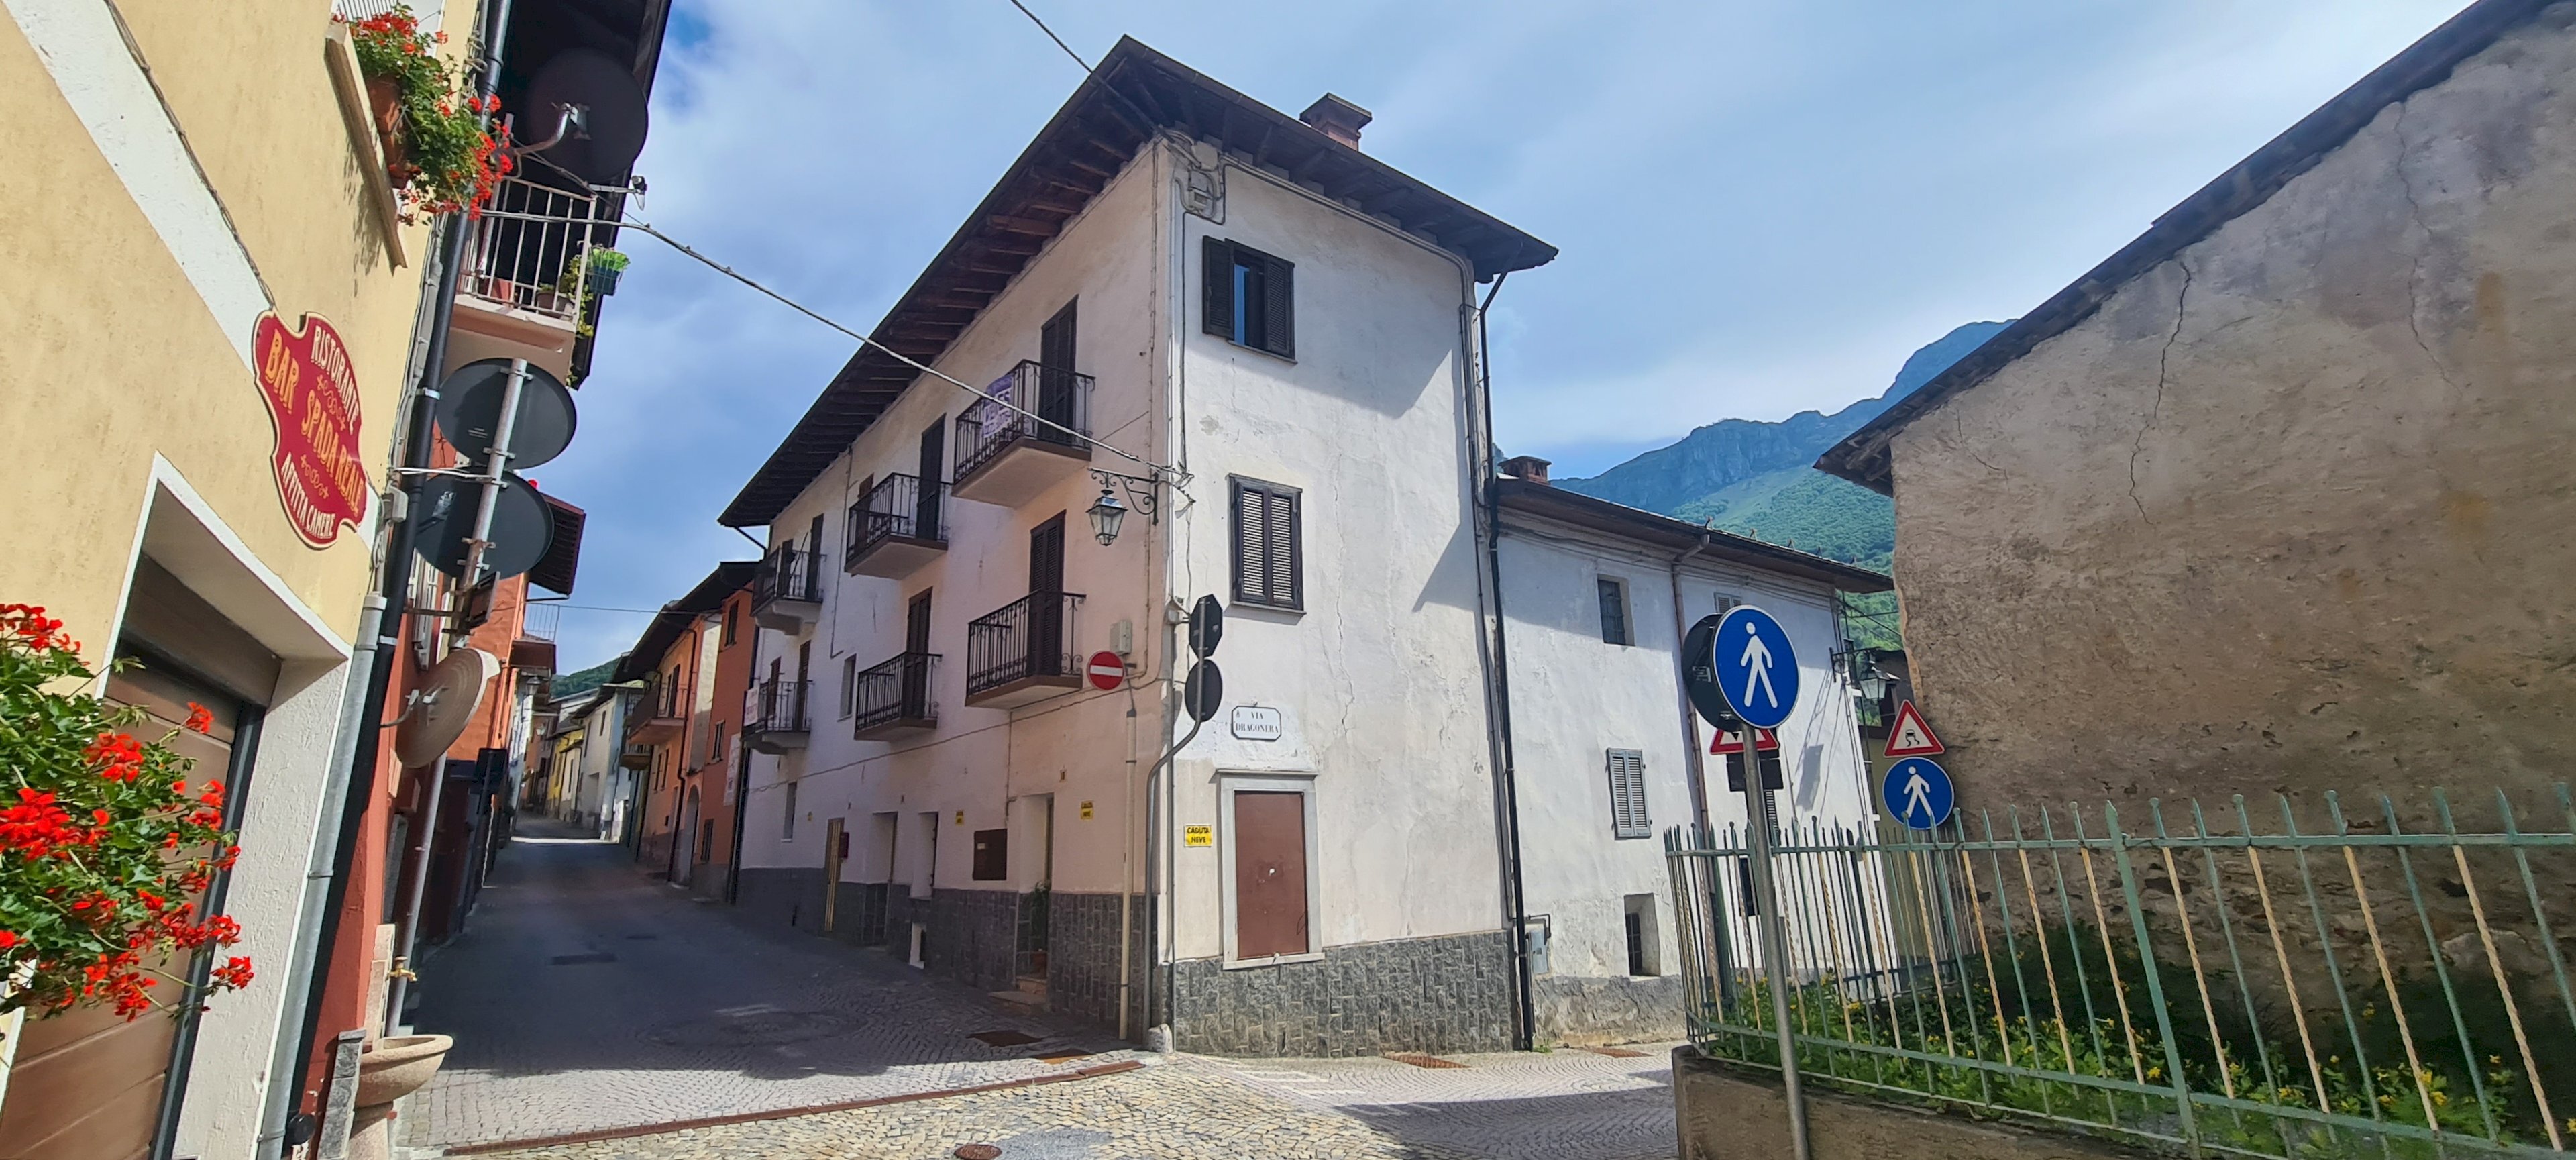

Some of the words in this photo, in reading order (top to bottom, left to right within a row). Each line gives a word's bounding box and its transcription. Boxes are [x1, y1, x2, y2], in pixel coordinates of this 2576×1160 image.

[265, 329, 300, 415] BAR
[310, 325, 360, 435] RISTORANTE
[280, 450, 309, 527] AFFITTA
[306, 504, 336, 539] CAMERE
[301, 389, 339, 478] SPADA
[334, 443, 366, 517] REALE
[1235, 722, 1279, 733] DRAGONERA
[1251, 711, 1263, 720] VIA
[1187, 826, 1210, 835] CADUTA
